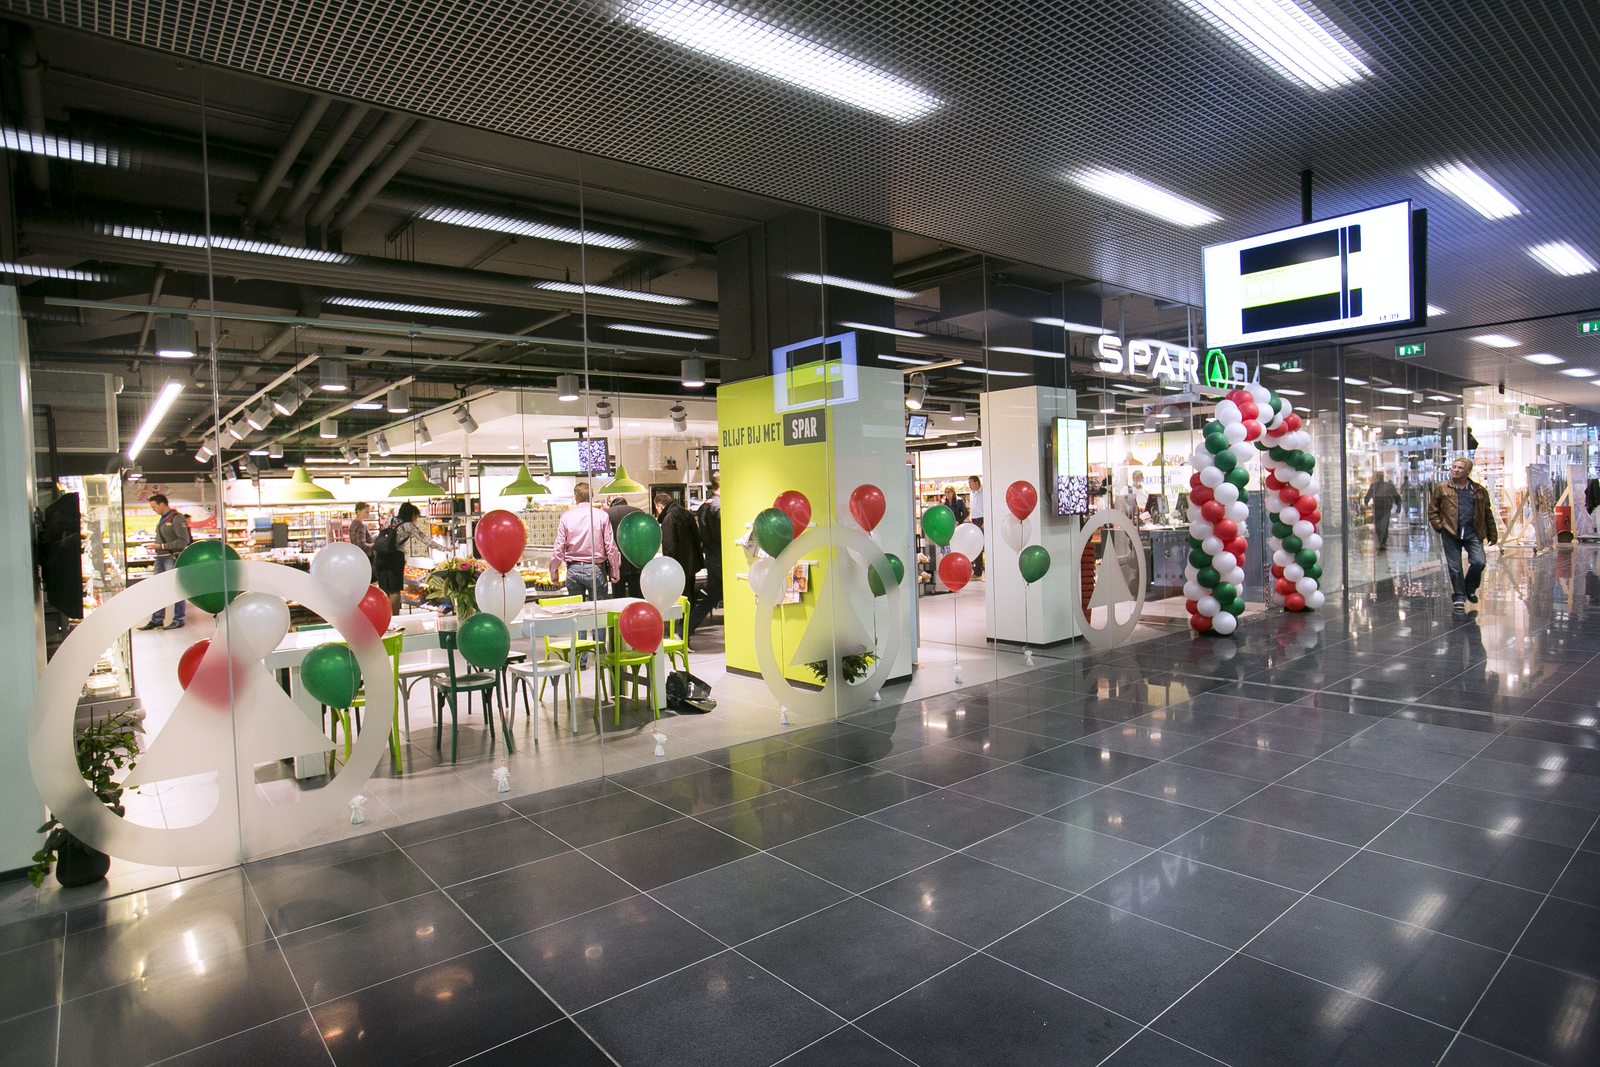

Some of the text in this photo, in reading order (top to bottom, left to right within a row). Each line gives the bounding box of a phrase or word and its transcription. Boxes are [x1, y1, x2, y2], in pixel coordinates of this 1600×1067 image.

[1094, 334, 1200, 385] SPAR
[722, 416, 818, 448] BLIJF BIJ MET SPAR
